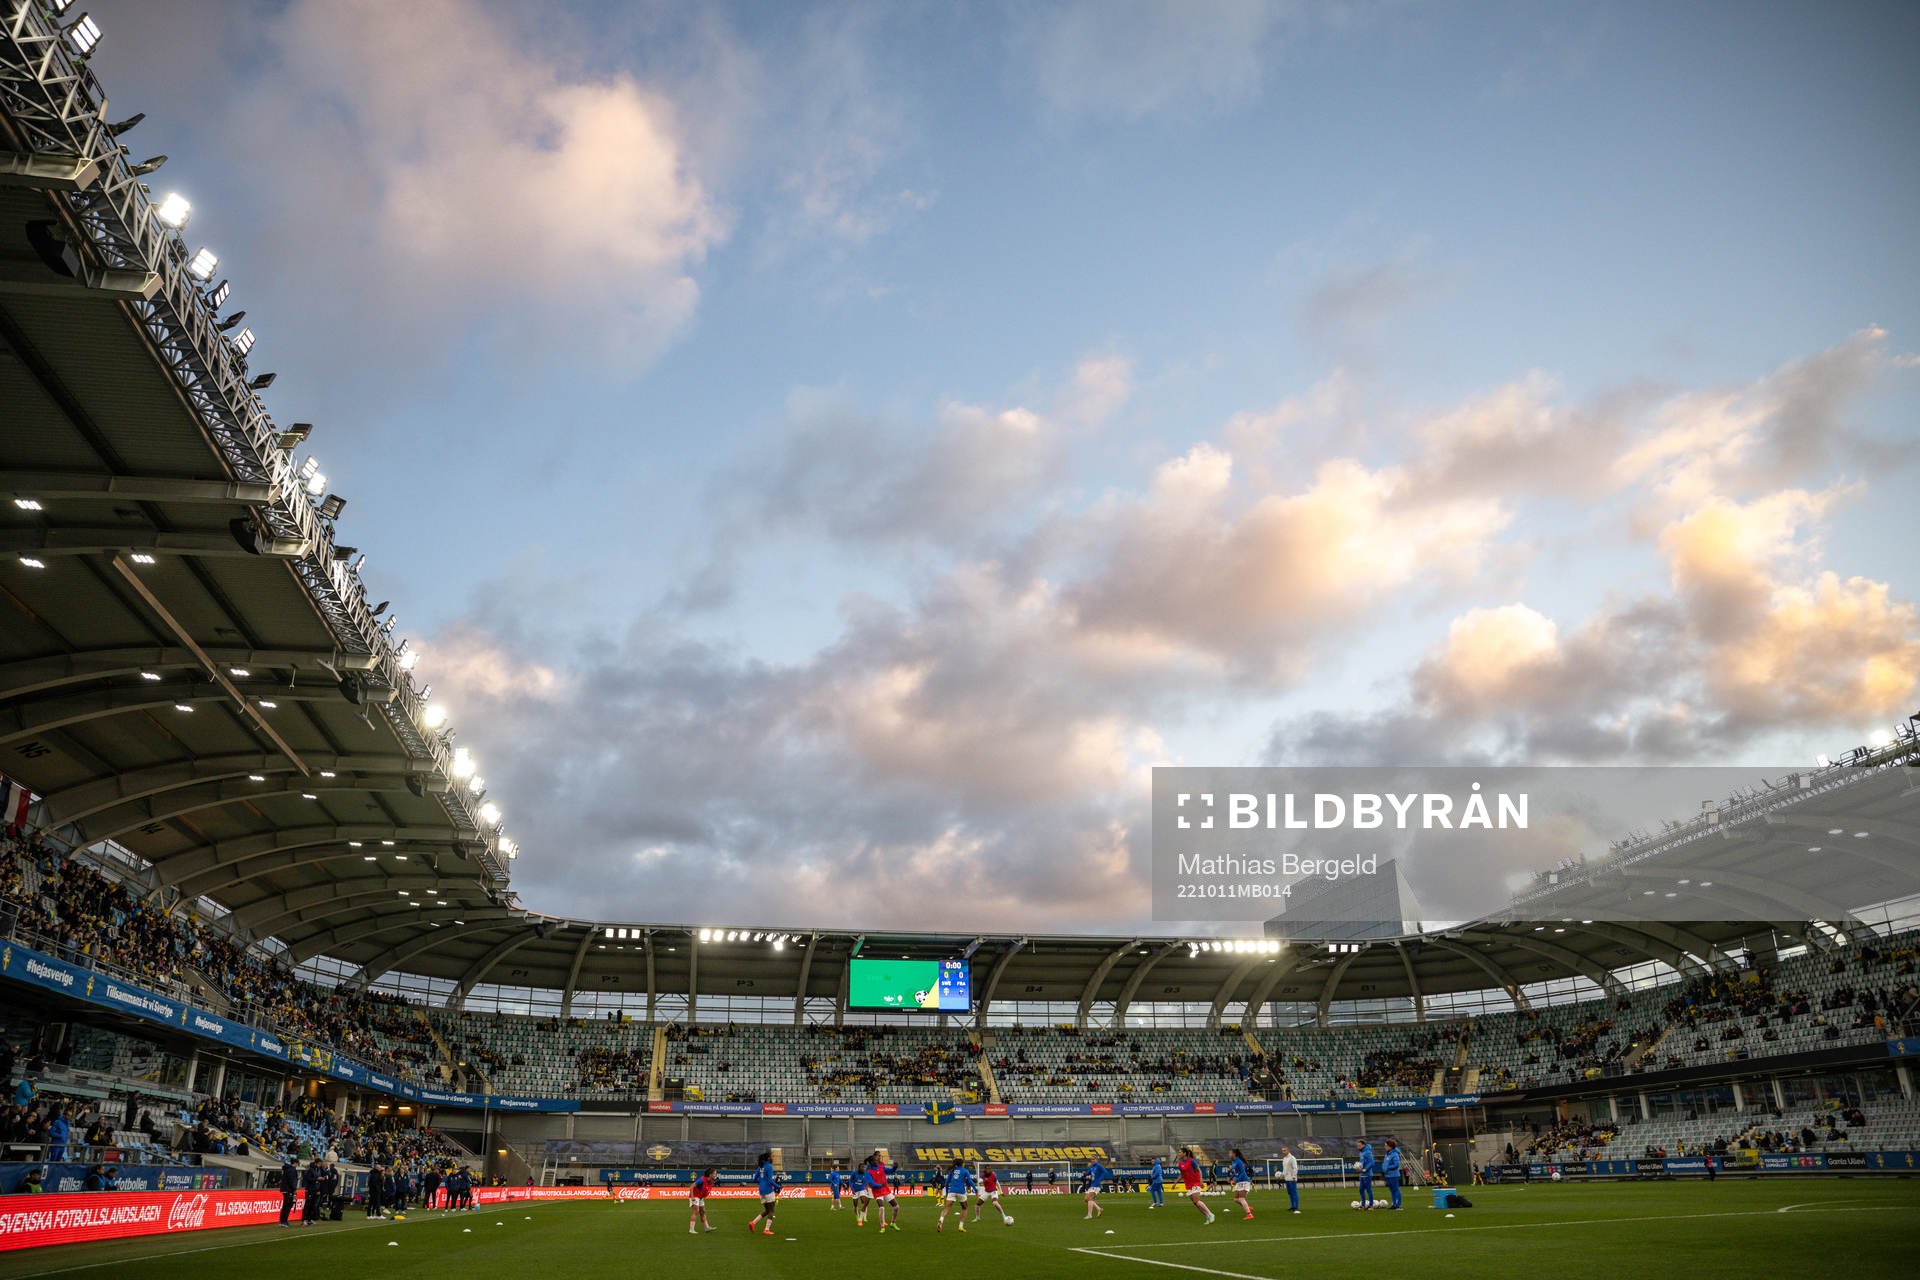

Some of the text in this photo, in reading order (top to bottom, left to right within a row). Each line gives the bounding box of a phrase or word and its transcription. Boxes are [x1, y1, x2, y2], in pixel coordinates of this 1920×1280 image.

[26, 958, 74, 987] #hejasverige
[106, 985, 142, 1007] Tillsammans
[915, 1146, 1109, 1162] HEJA SVERIGE!
[634, 1172, 676, 1180] #hejasverige
[0, 1211, 53, 1235] SVENSKA
[53, 1205, 161, 1229] FOTBOLLSLANDSLAGEN
[215, 1202, 227, 1216] TILL
[227, 1200, 252, 1216] SVENSKA
